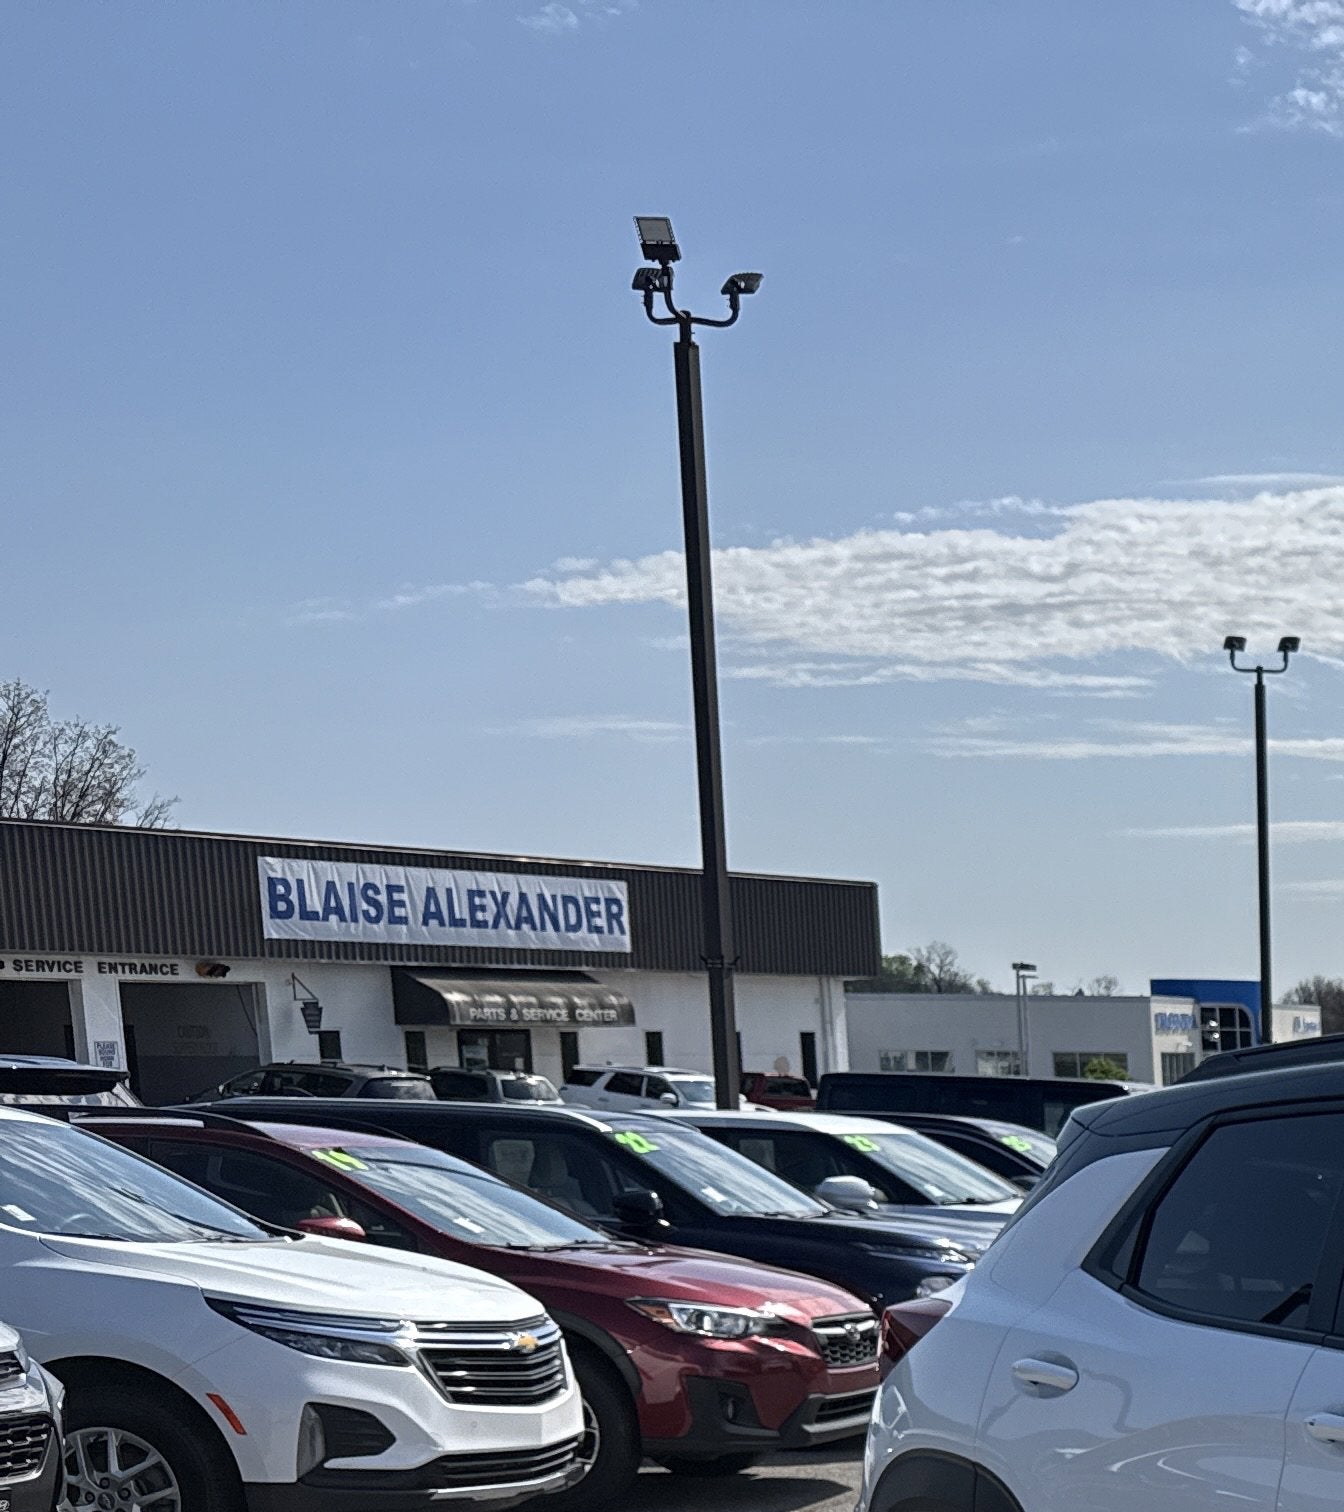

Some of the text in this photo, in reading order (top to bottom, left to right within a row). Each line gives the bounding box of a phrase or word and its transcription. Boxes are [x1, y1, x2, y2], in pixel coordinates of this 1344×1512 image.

[267, 876, 626, 936] BLAISE ALEXANDER
[13, 959, 179, 976] SERVICE ENTRANCE
[469, 1008, 507, 1021] PARTS
[522, 1008, 569, 1022] SERVICE
[575, 1008, 618, 1022] CENTER
